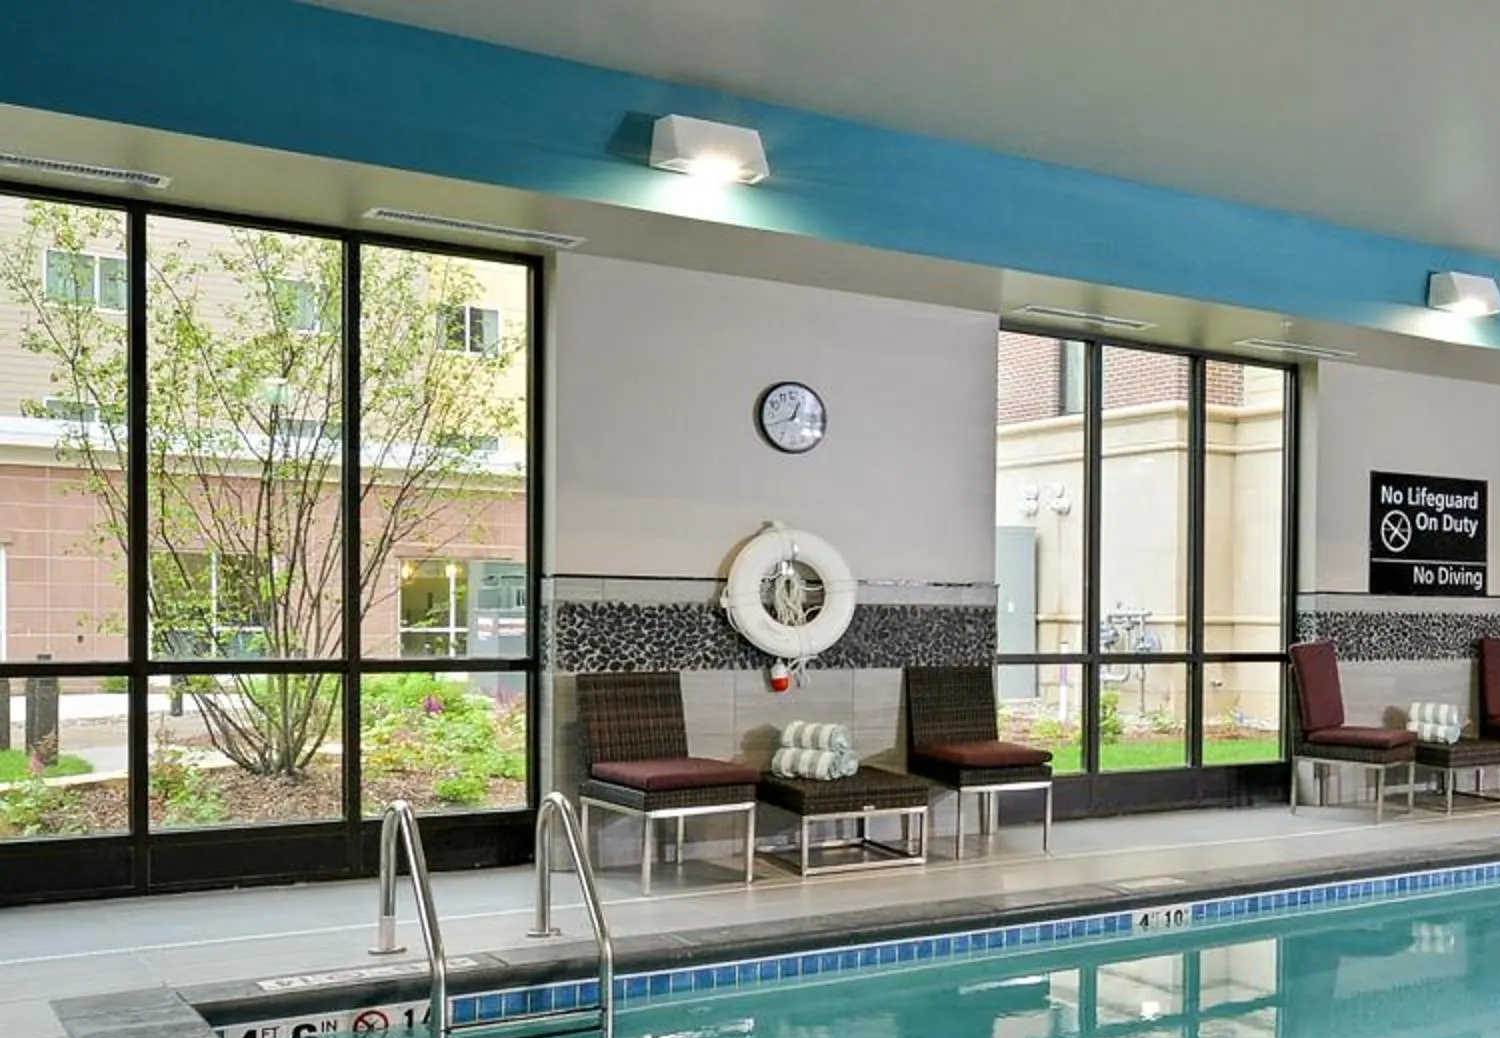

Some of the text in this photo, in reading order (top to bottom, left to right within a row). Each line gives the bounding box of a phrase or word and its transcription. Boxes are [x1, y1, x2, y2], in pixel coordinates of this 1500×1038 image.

[1381, 485, 1478, 512] No Lifeguard
[1416, 512, 1478, 538] On Duty
[1414, 566, 1482, 590] No Diving
[321, 1020, 337, 1033] IN
